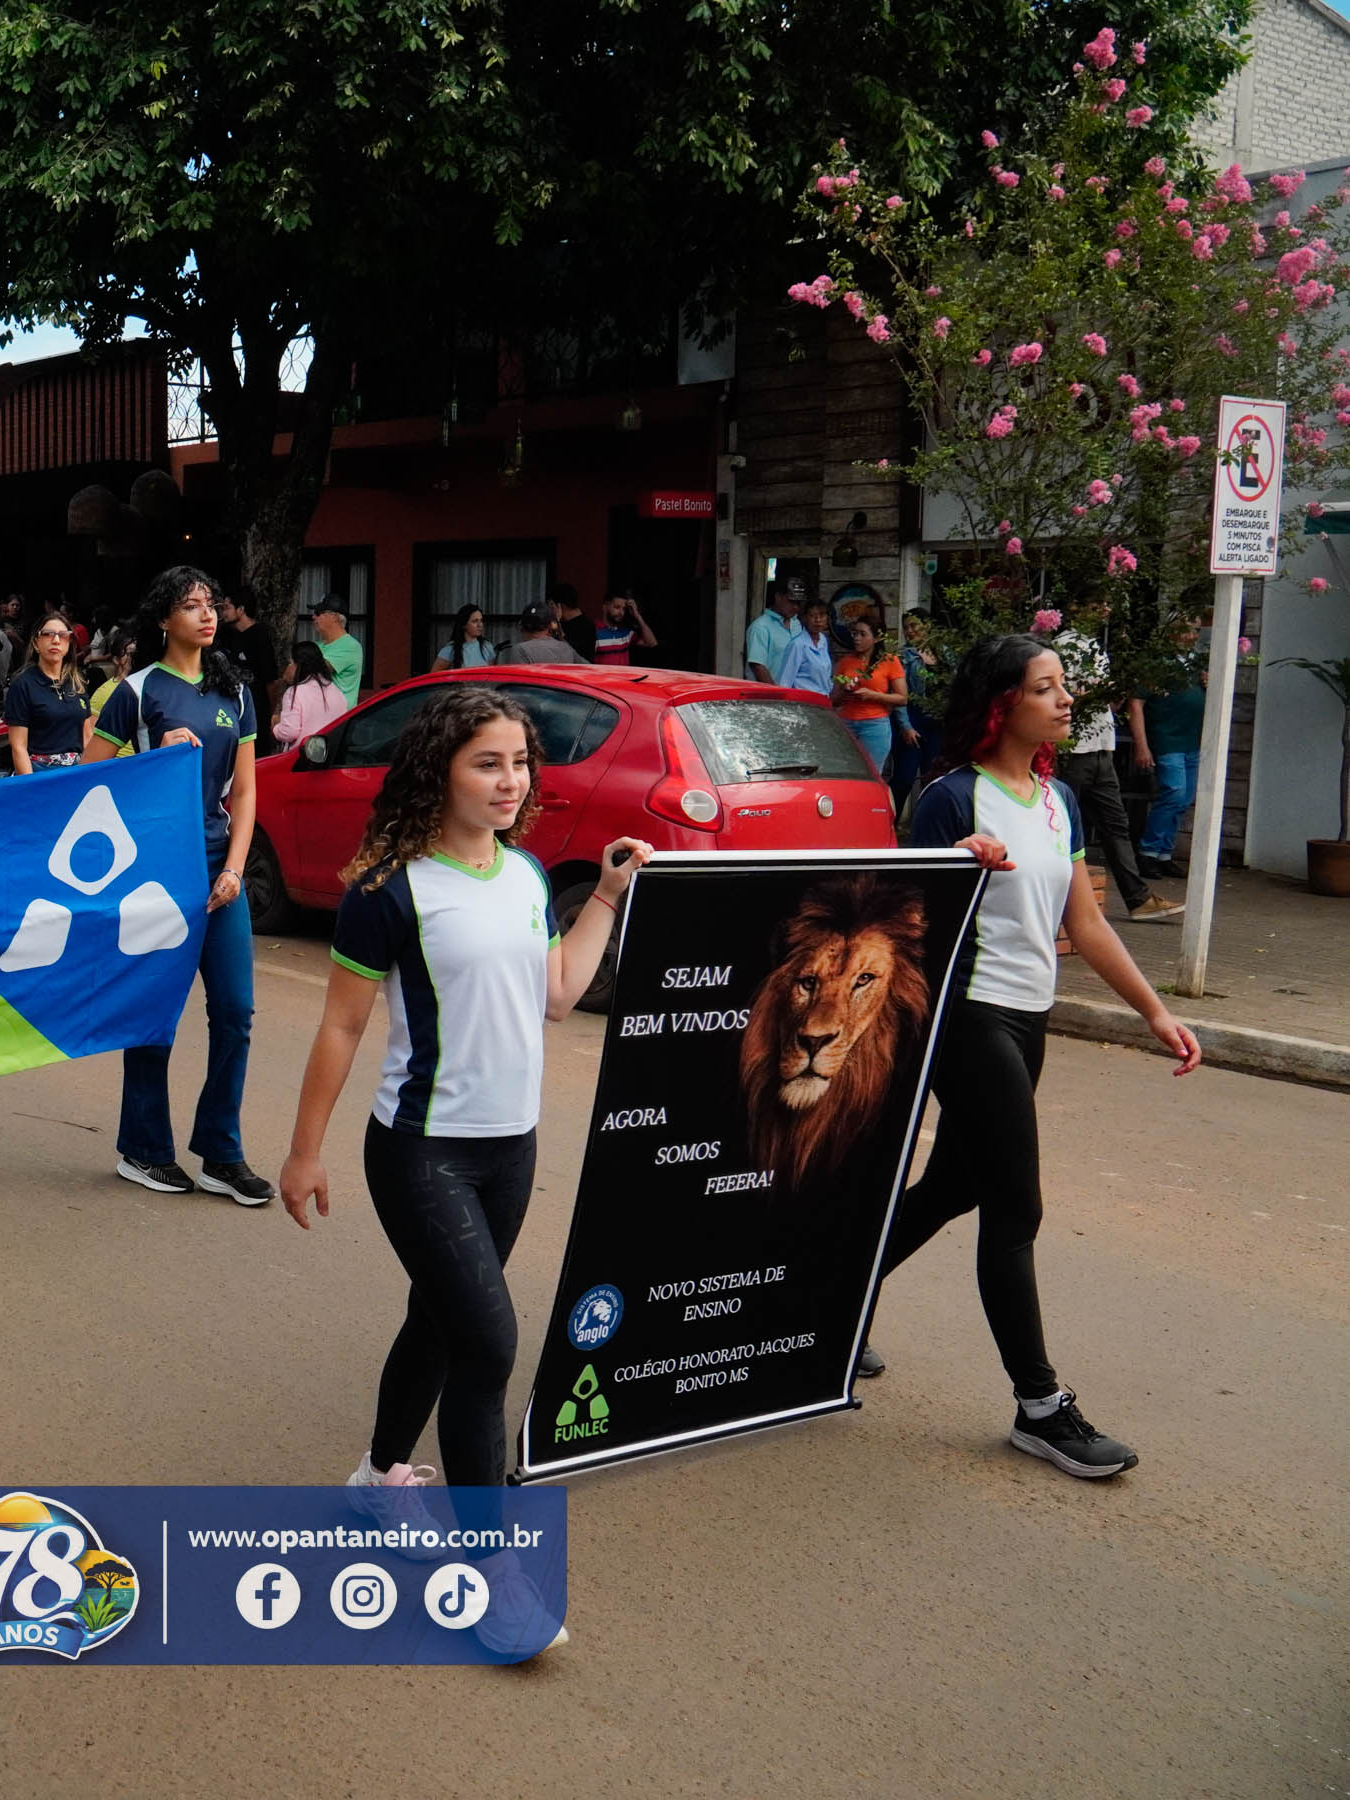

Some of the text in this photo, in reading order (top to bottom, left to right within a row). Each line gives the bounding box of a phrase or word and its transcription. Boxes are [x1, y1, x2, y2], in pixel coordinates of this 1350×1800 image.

[655, 498, 712, 511] Pastel Bonito
[1225, 508, 1267, 519] EMBARQUE E
[1221, 519, 1270, 530] DESEMBARQUE
[1227, 531, 1262, 541] 5 MINUTOS
[1226, 541, 1241, 551] COM
[1242, 542, 1261, 551] PISCA
[1218, 554, 1269, 563] ALERTA LIGADO
[661, 965, 732, 988] SEJAM
[620, 1008, 750, 1037] BEM VINDOS
[600, 1106, 668, 1131] AGORA
[654, 1141, 721, 1165] SOMOS
[704, 1169, 775, 1195] FEEERA!
[647, 1265, 786, 1302] NOVO SISTEMA DE
[683, 1298, 742, 1321] ENSINO
[577, 1325, 608, 1343] anglo
[614, 1332, 815, 1383] COLÉGIO HONORATO JACQUES
[675, 1366, 749, 1394] BONITO MS
[554, 1418, 609, 1443] FUNLEC
